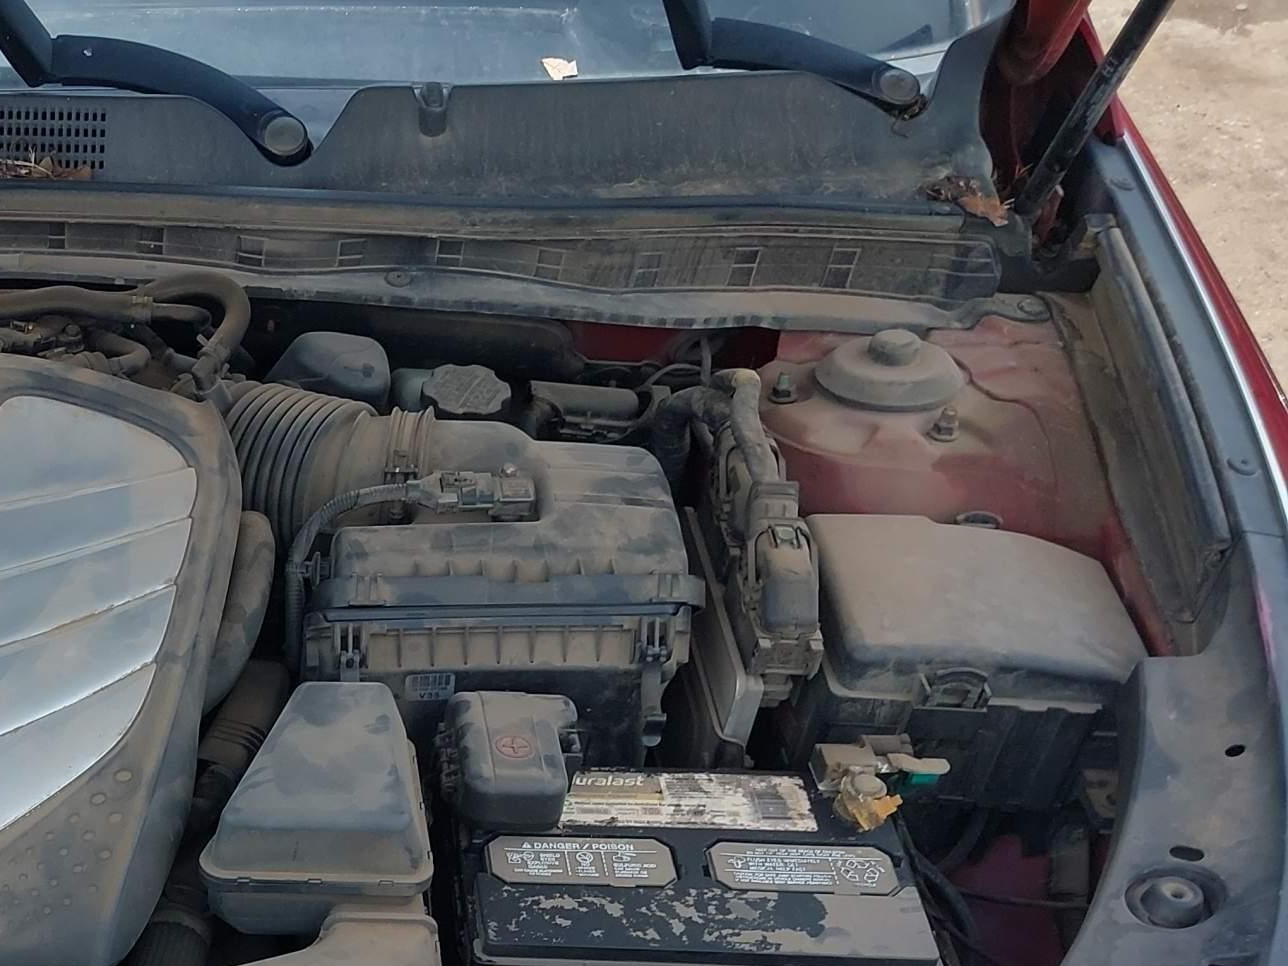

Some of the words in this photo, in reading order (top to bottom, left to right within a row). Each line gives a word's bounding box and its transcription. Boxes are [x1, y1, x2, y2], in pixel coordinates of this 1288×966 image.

[572, 774, 644, 787] uralast
[533, 841, 580, 850] DANGER
[582, 842, 590, 850] /
[592, 842, 634, 851] POISON
